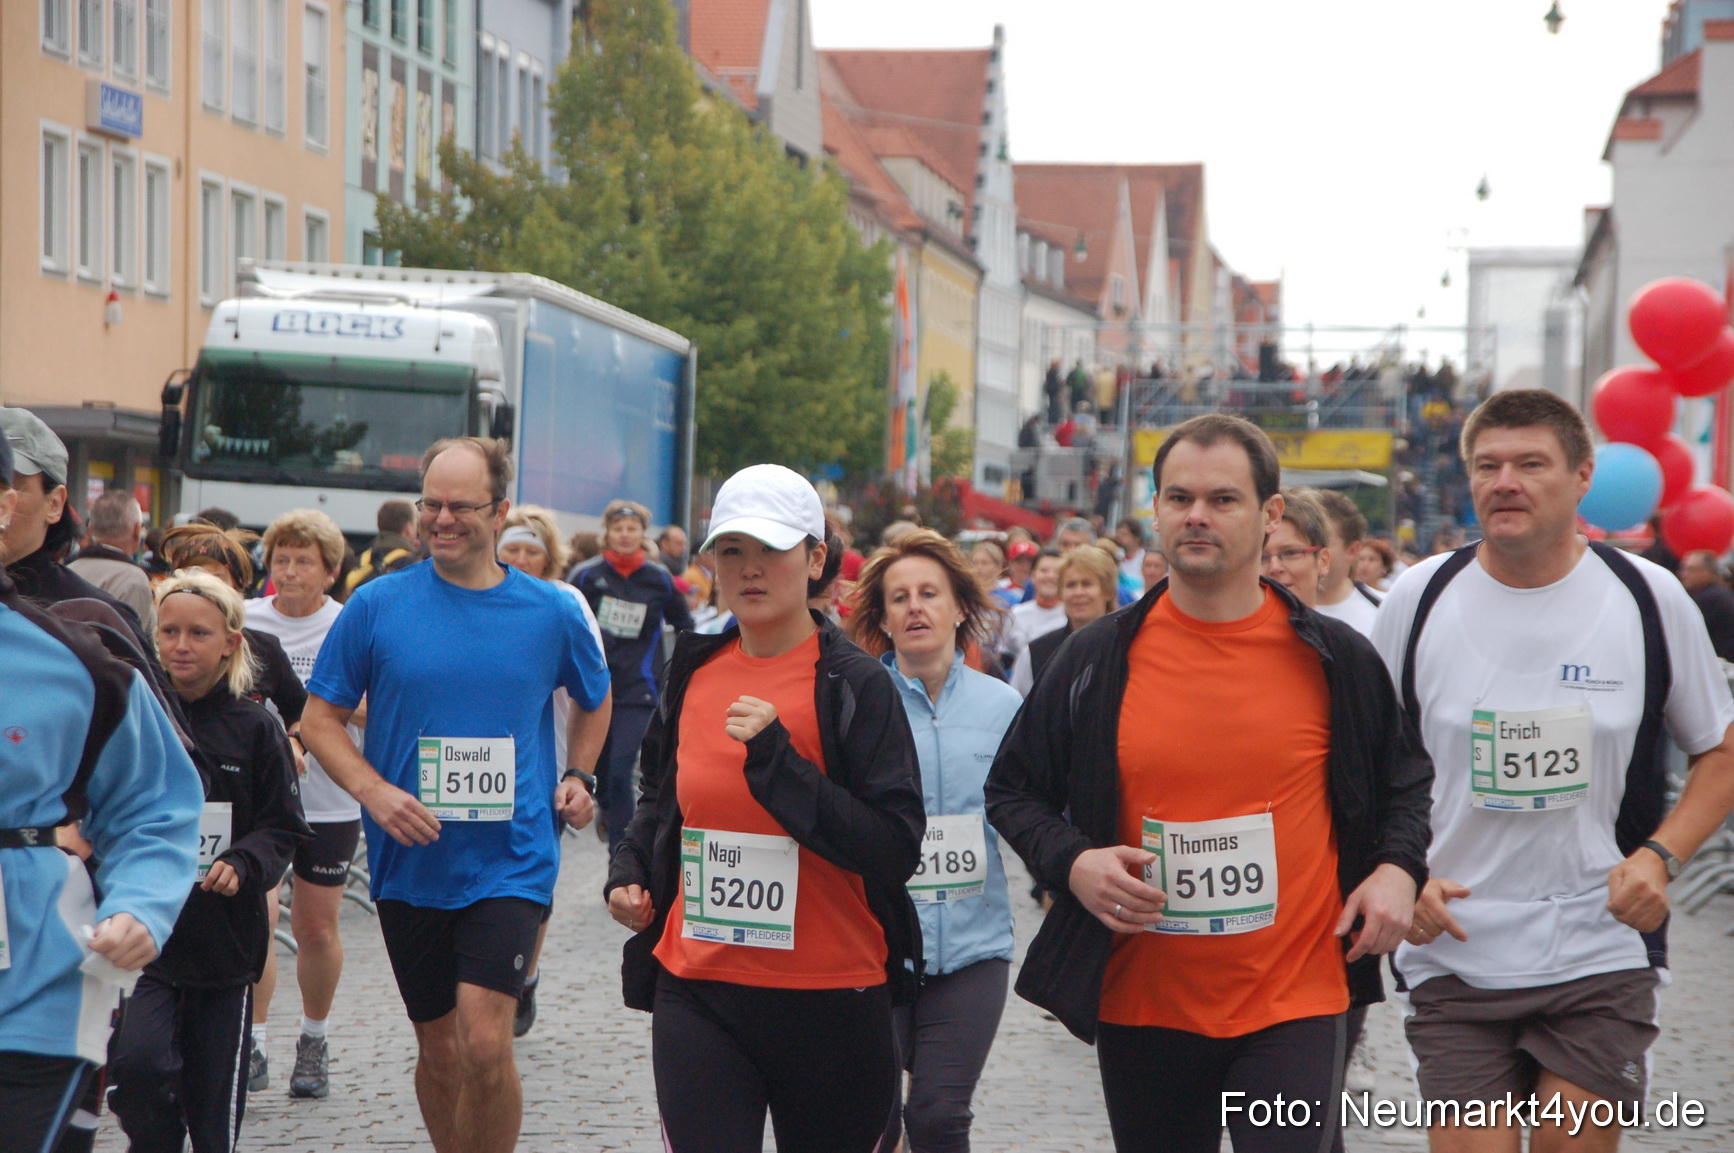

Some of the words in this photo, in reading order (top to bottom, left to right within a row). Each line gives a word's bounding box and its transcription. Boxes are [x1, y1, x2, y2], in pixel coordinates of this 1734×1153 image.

[272, 309, 404, 338] BOCK
[1500, 721, 1541, 740] Erich
[445, 746, 490, 761] Oswald
[1475, 747, 1482, 760] S
[220, 764, 241, 773] ALEX
[1503, 748, 1580, 779] 5123
[422, 770, 428, 781] S
[446, 771, 506, 794] 5100
[1169, 833, 1239, 855] Thomas
[709, 841, 741, 868] Nagi
[312, 864, 344, 875] JAKO
[1145, 863, 1152, 878] S
[685, 871, 692, 886] S
[1176, 863, 1264, 899] 5199
[710, 876, 784, 912] 5200
[1225, 910, 1274, 926] PFLEIDERER
[746, 929, 792, 942] PFLEIDERER
